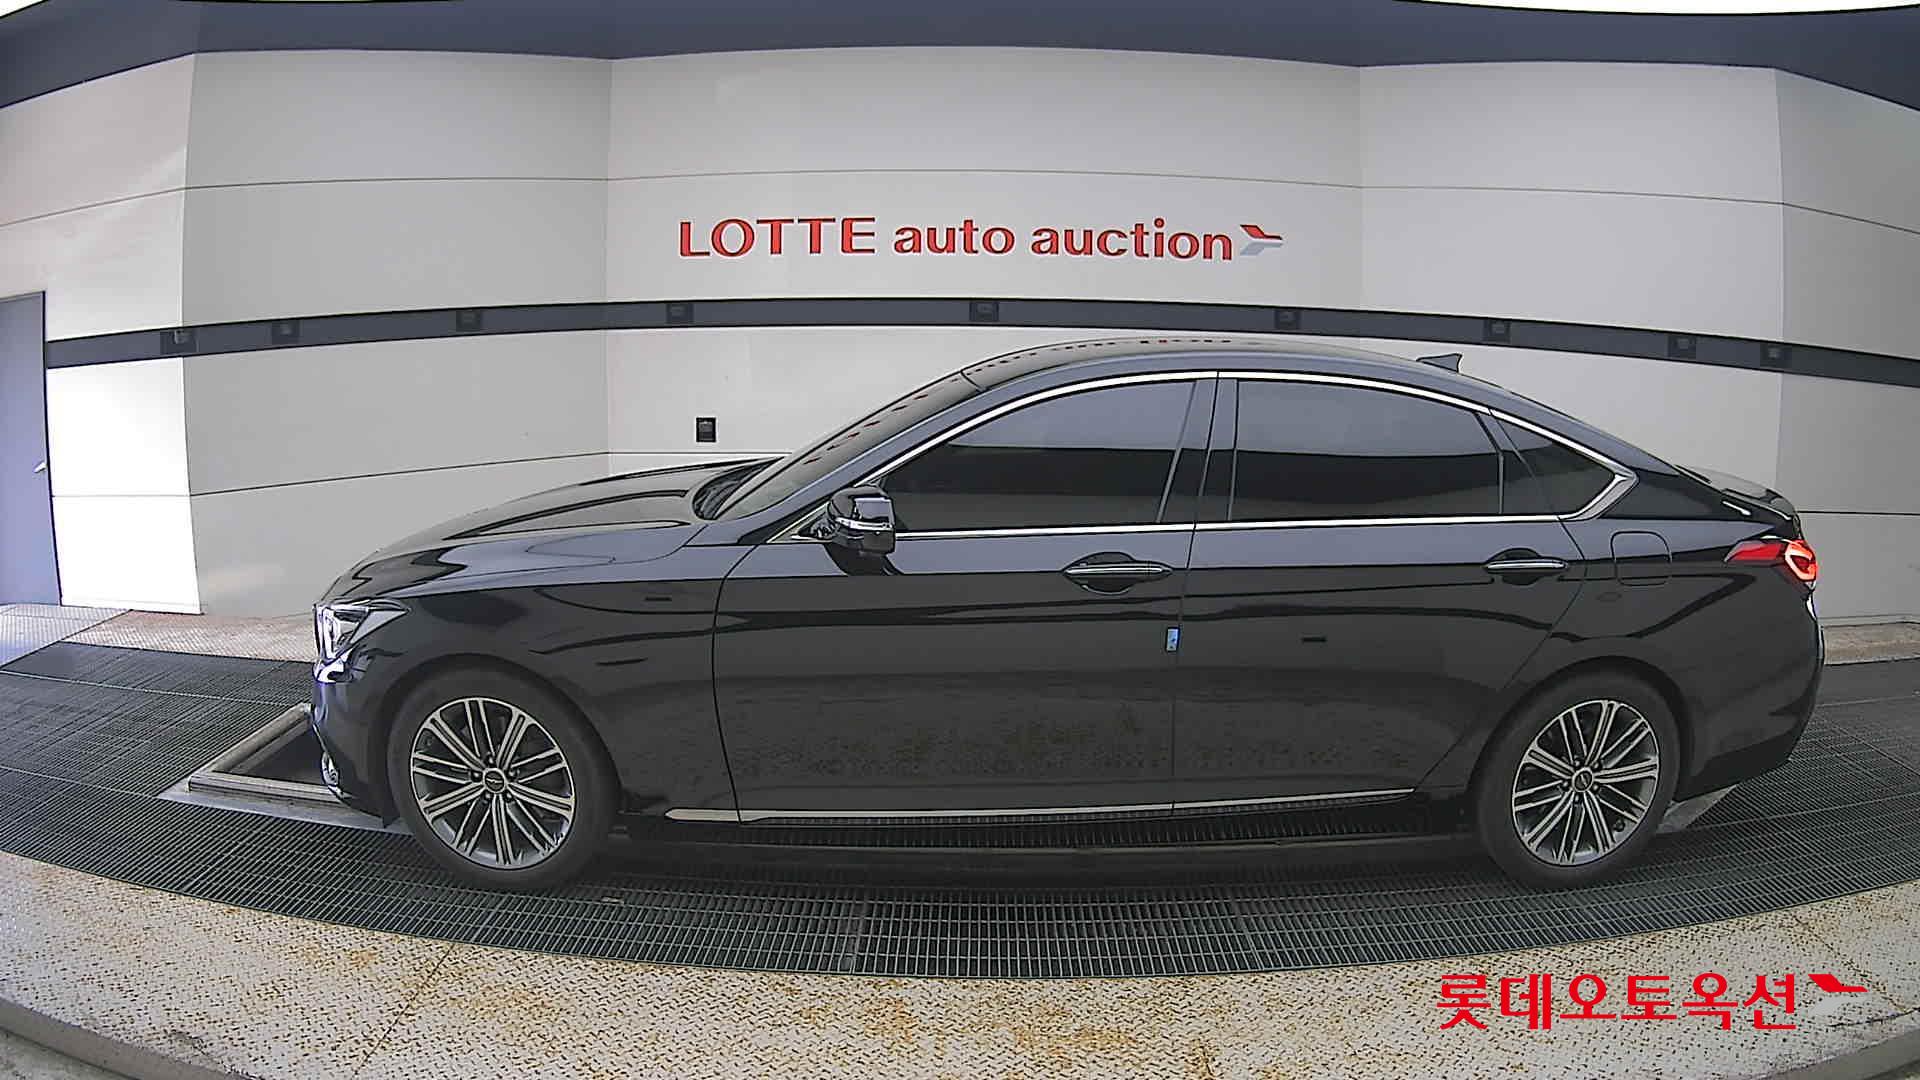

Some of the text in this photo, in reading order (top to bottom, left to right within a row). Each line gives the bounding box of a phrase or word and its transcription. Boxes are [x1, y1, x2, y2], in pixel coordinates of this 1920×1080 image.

[679, 217, 1234, 261] LOTTE auto auction
